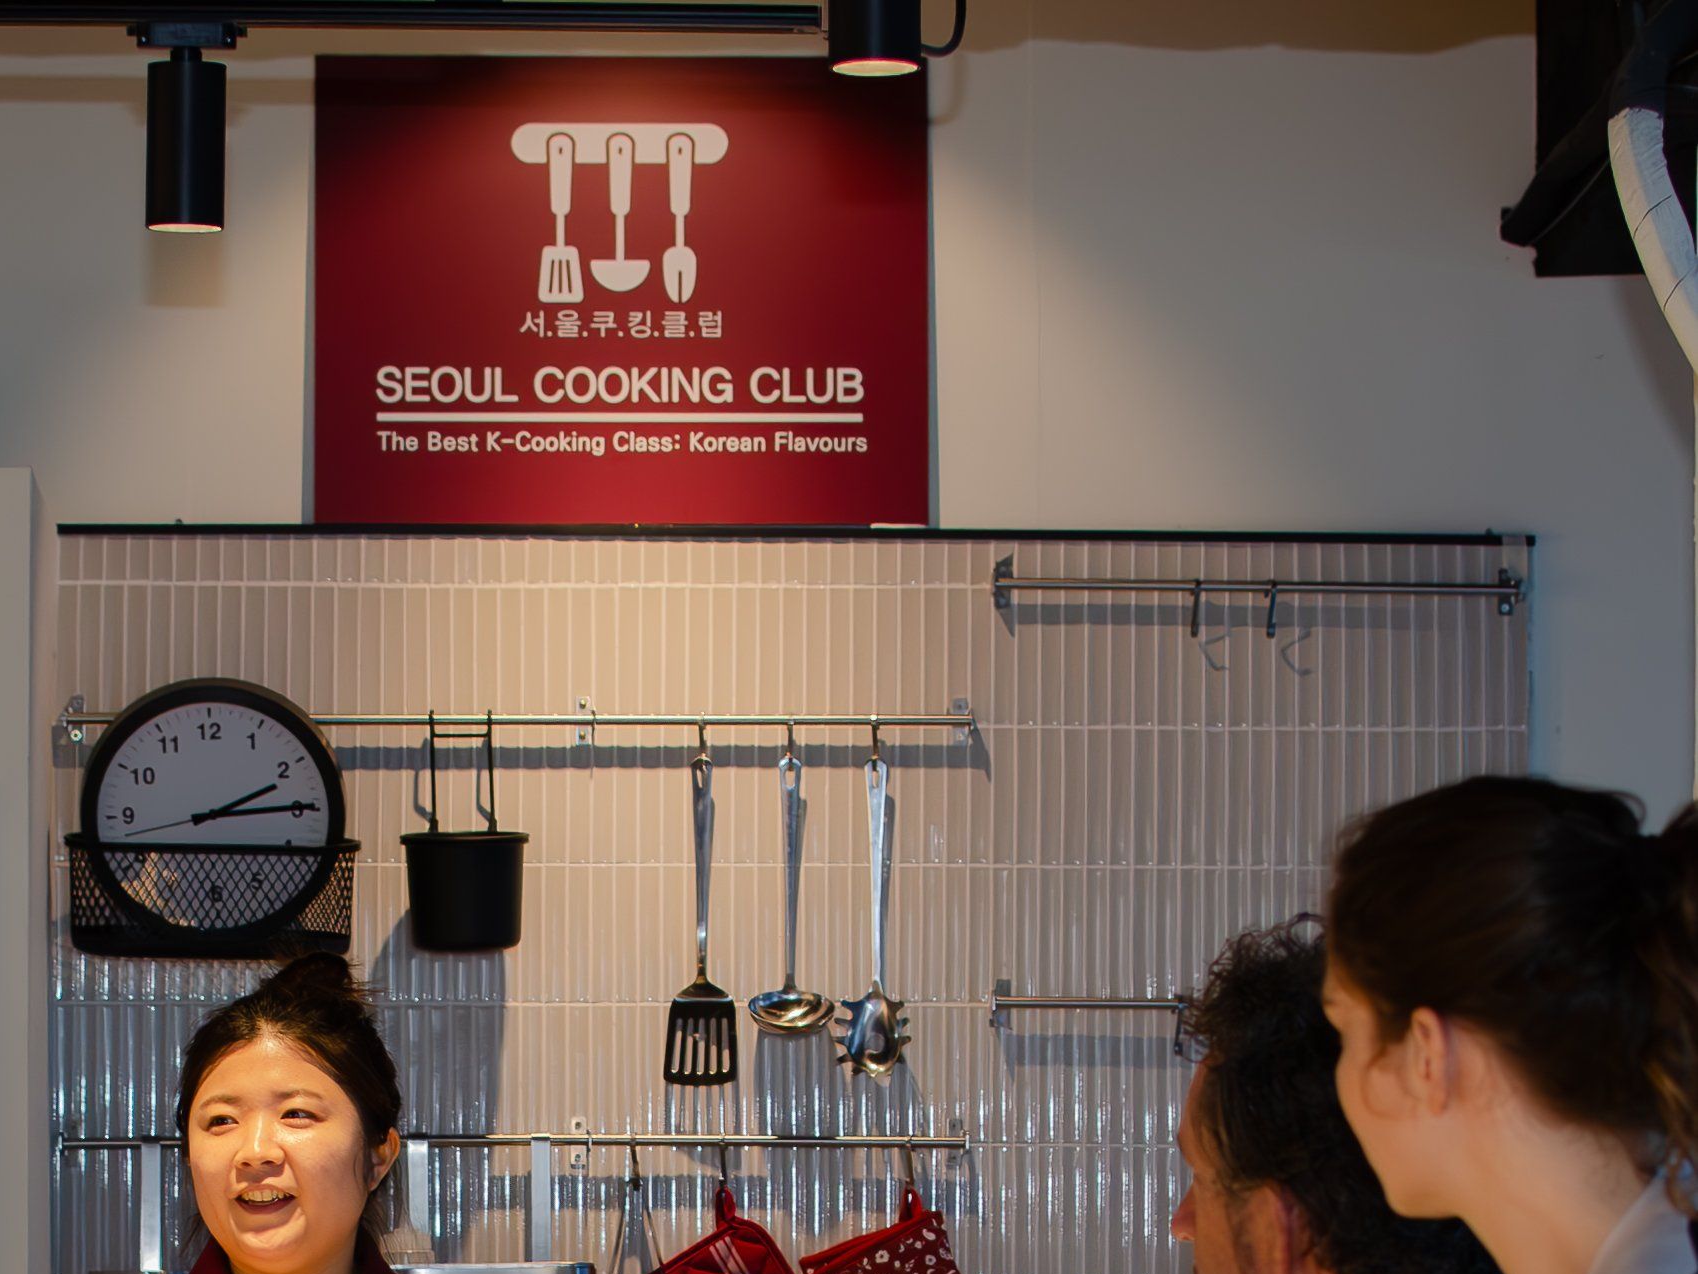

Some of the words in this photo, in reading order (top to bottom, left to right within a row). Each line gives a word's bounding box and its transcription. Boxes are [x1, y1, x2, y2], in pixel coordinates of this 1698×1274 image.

[519, 310, 723, 338] 서.울.쿠.킹.클.럽
[376, 366, 518, 403] SEOUL
[533, 366, 734, 403] COOKING
[750, 366, 865, 403] CLUB
[377, 431, 419, 453] The
[427, 431, 478, 453] Best
[486, 431, 605, 456] K-Cooking
[613, 431, 681, 453] Class:
[690, 431, 766, 453] Korean
[775, 431, 868, 453] Flavours
[197, 722, 221, 740] 12
[158, 735, 179, 753] 11
[246, 732, 256, 750] 1
[130, 767, 155, 785] 10
[277, 761, 290, 779] 2
[122, 807, 135, 824] 9
